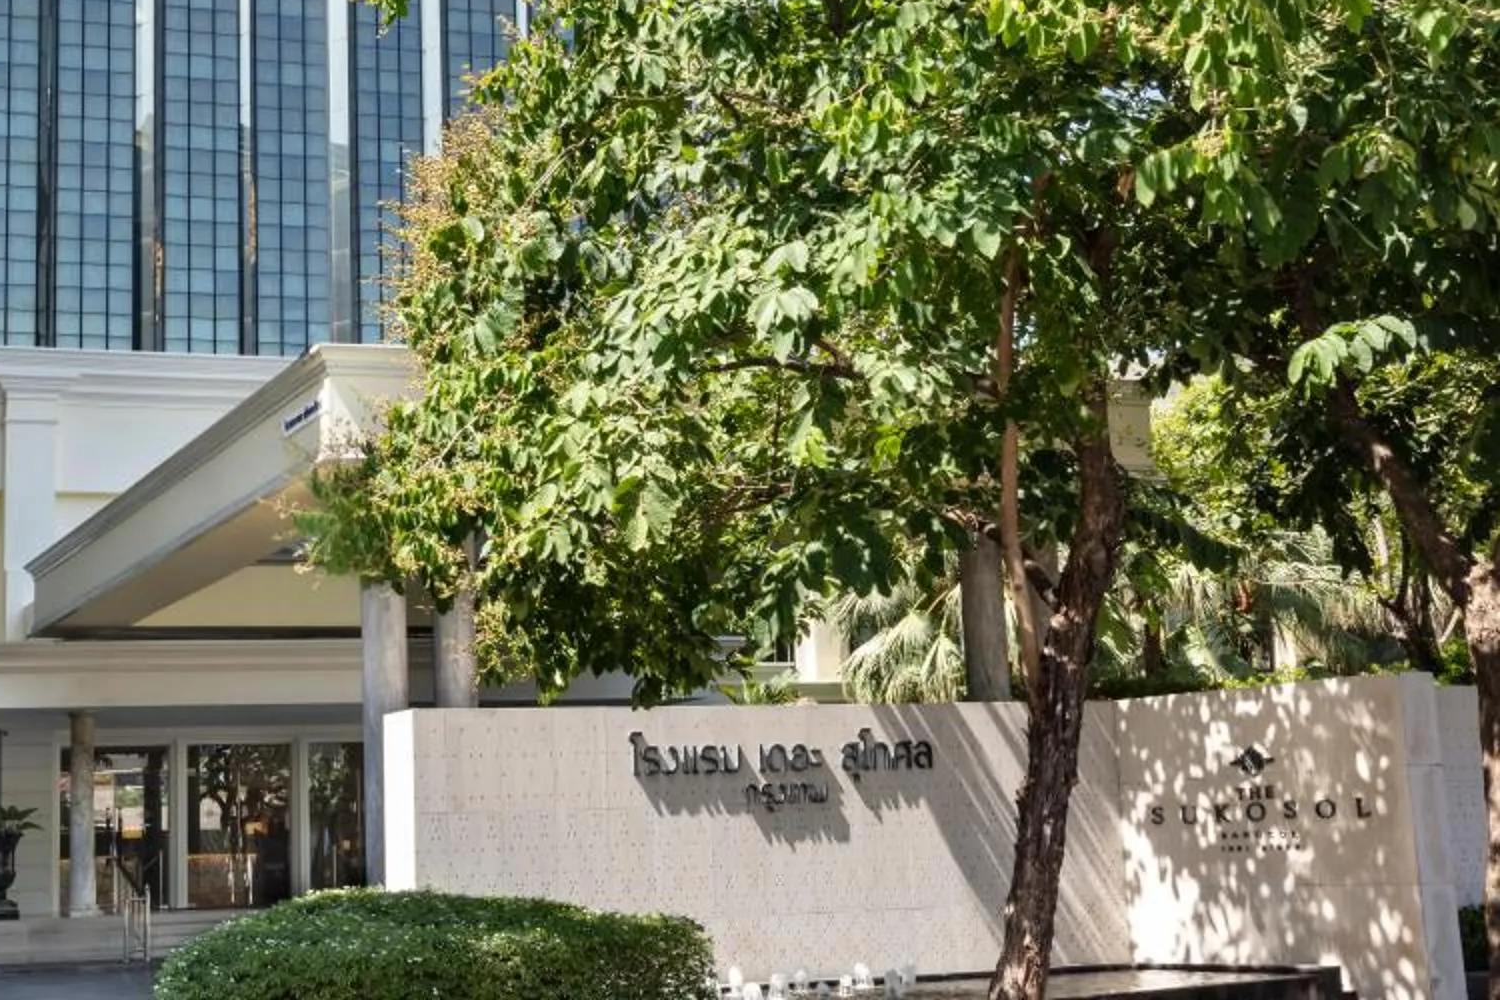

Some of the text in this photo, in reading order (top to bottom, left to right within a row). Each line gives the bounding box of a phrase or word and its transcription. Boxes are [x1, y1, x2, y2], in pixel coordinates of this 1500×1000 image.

[628, 727, 934, 784] โรงแรม เดอะ สุโกศล
[1236, 785, 1276, 801] THE
[1150, 797, 1373, 826] SUKOSOL
